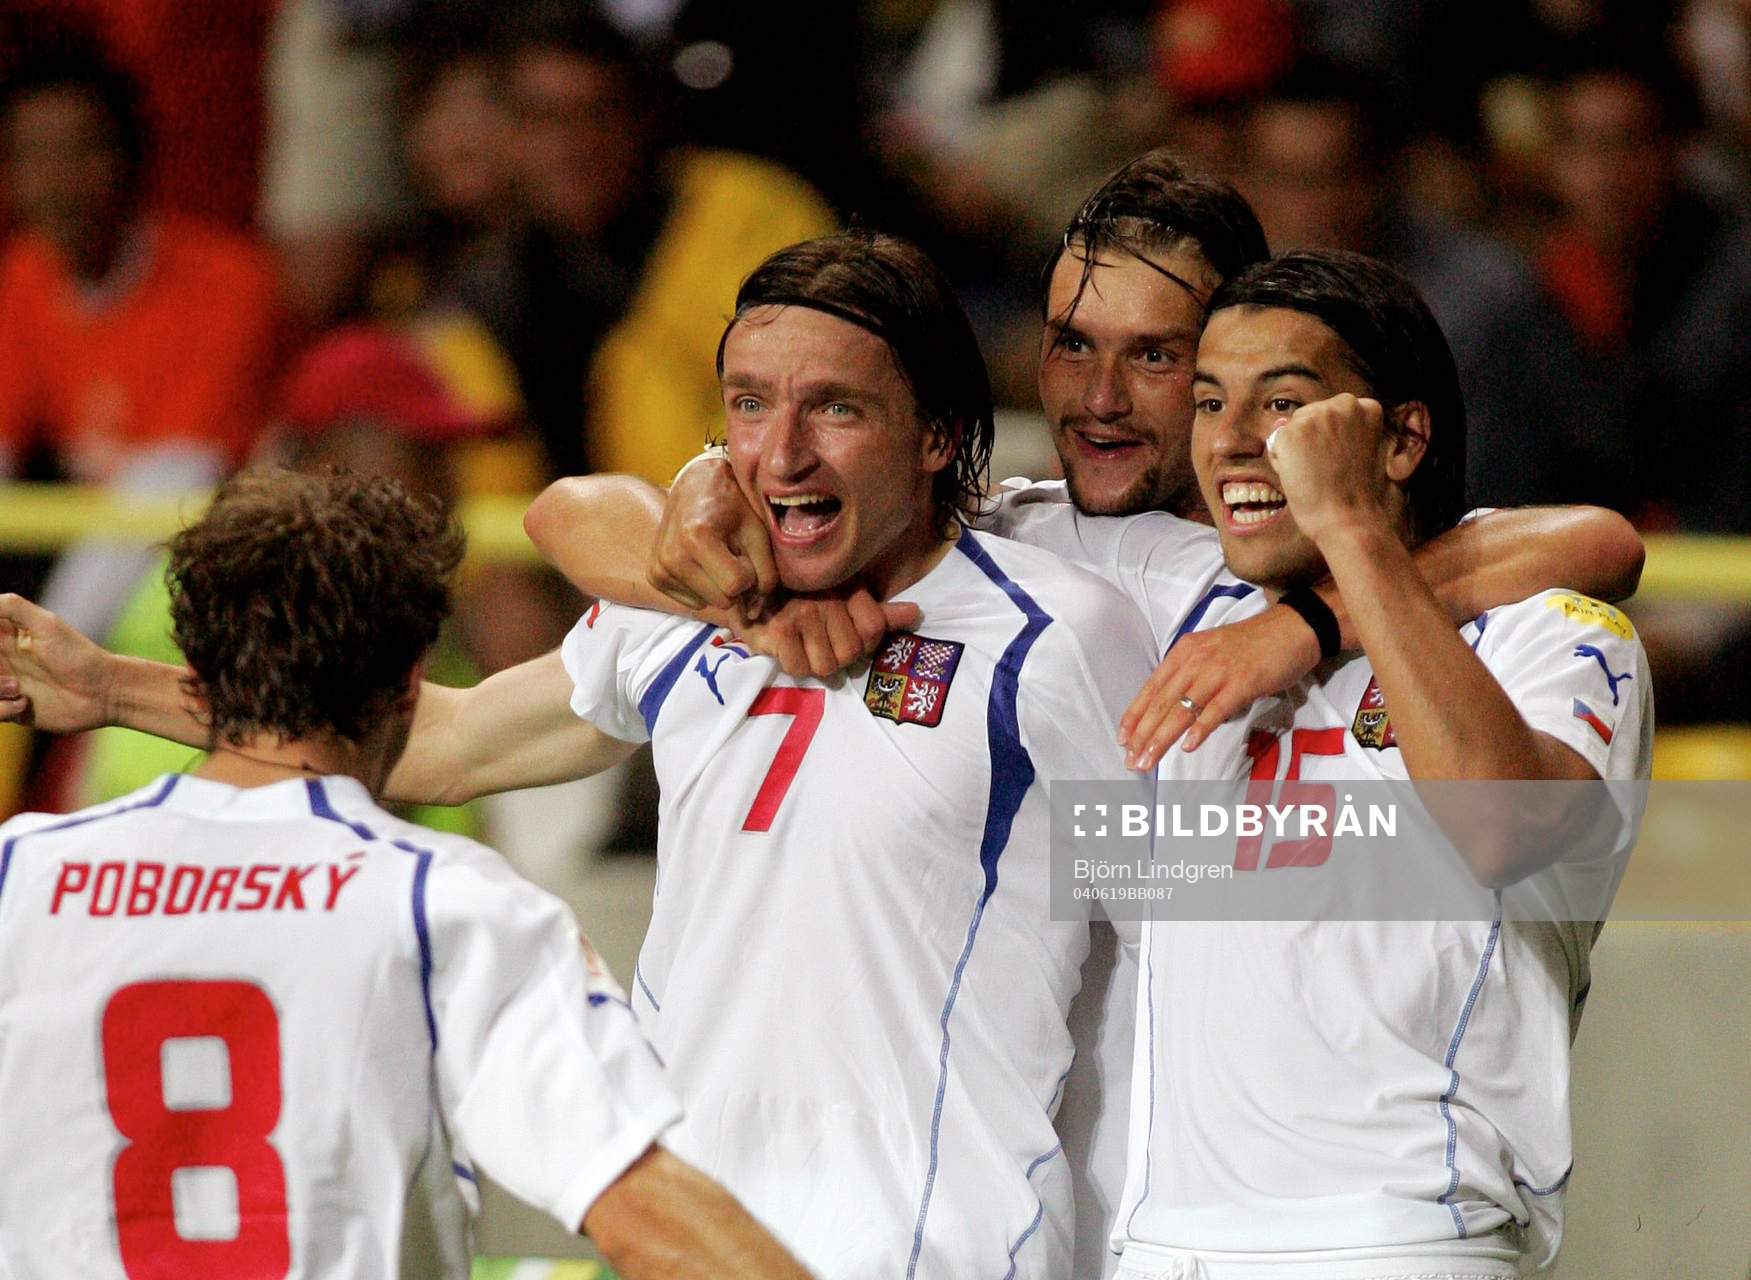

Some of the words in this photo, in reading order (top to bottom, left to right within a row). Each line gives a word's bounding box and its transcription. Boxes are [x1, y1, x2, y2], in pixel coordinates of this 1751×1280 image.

[743, 687, 825, 831] 7
[1233, 727, 1345, 871] 15
[49, 851, 366, 916] POBORSKÝ
[103, 979, 290, 1280] 8
